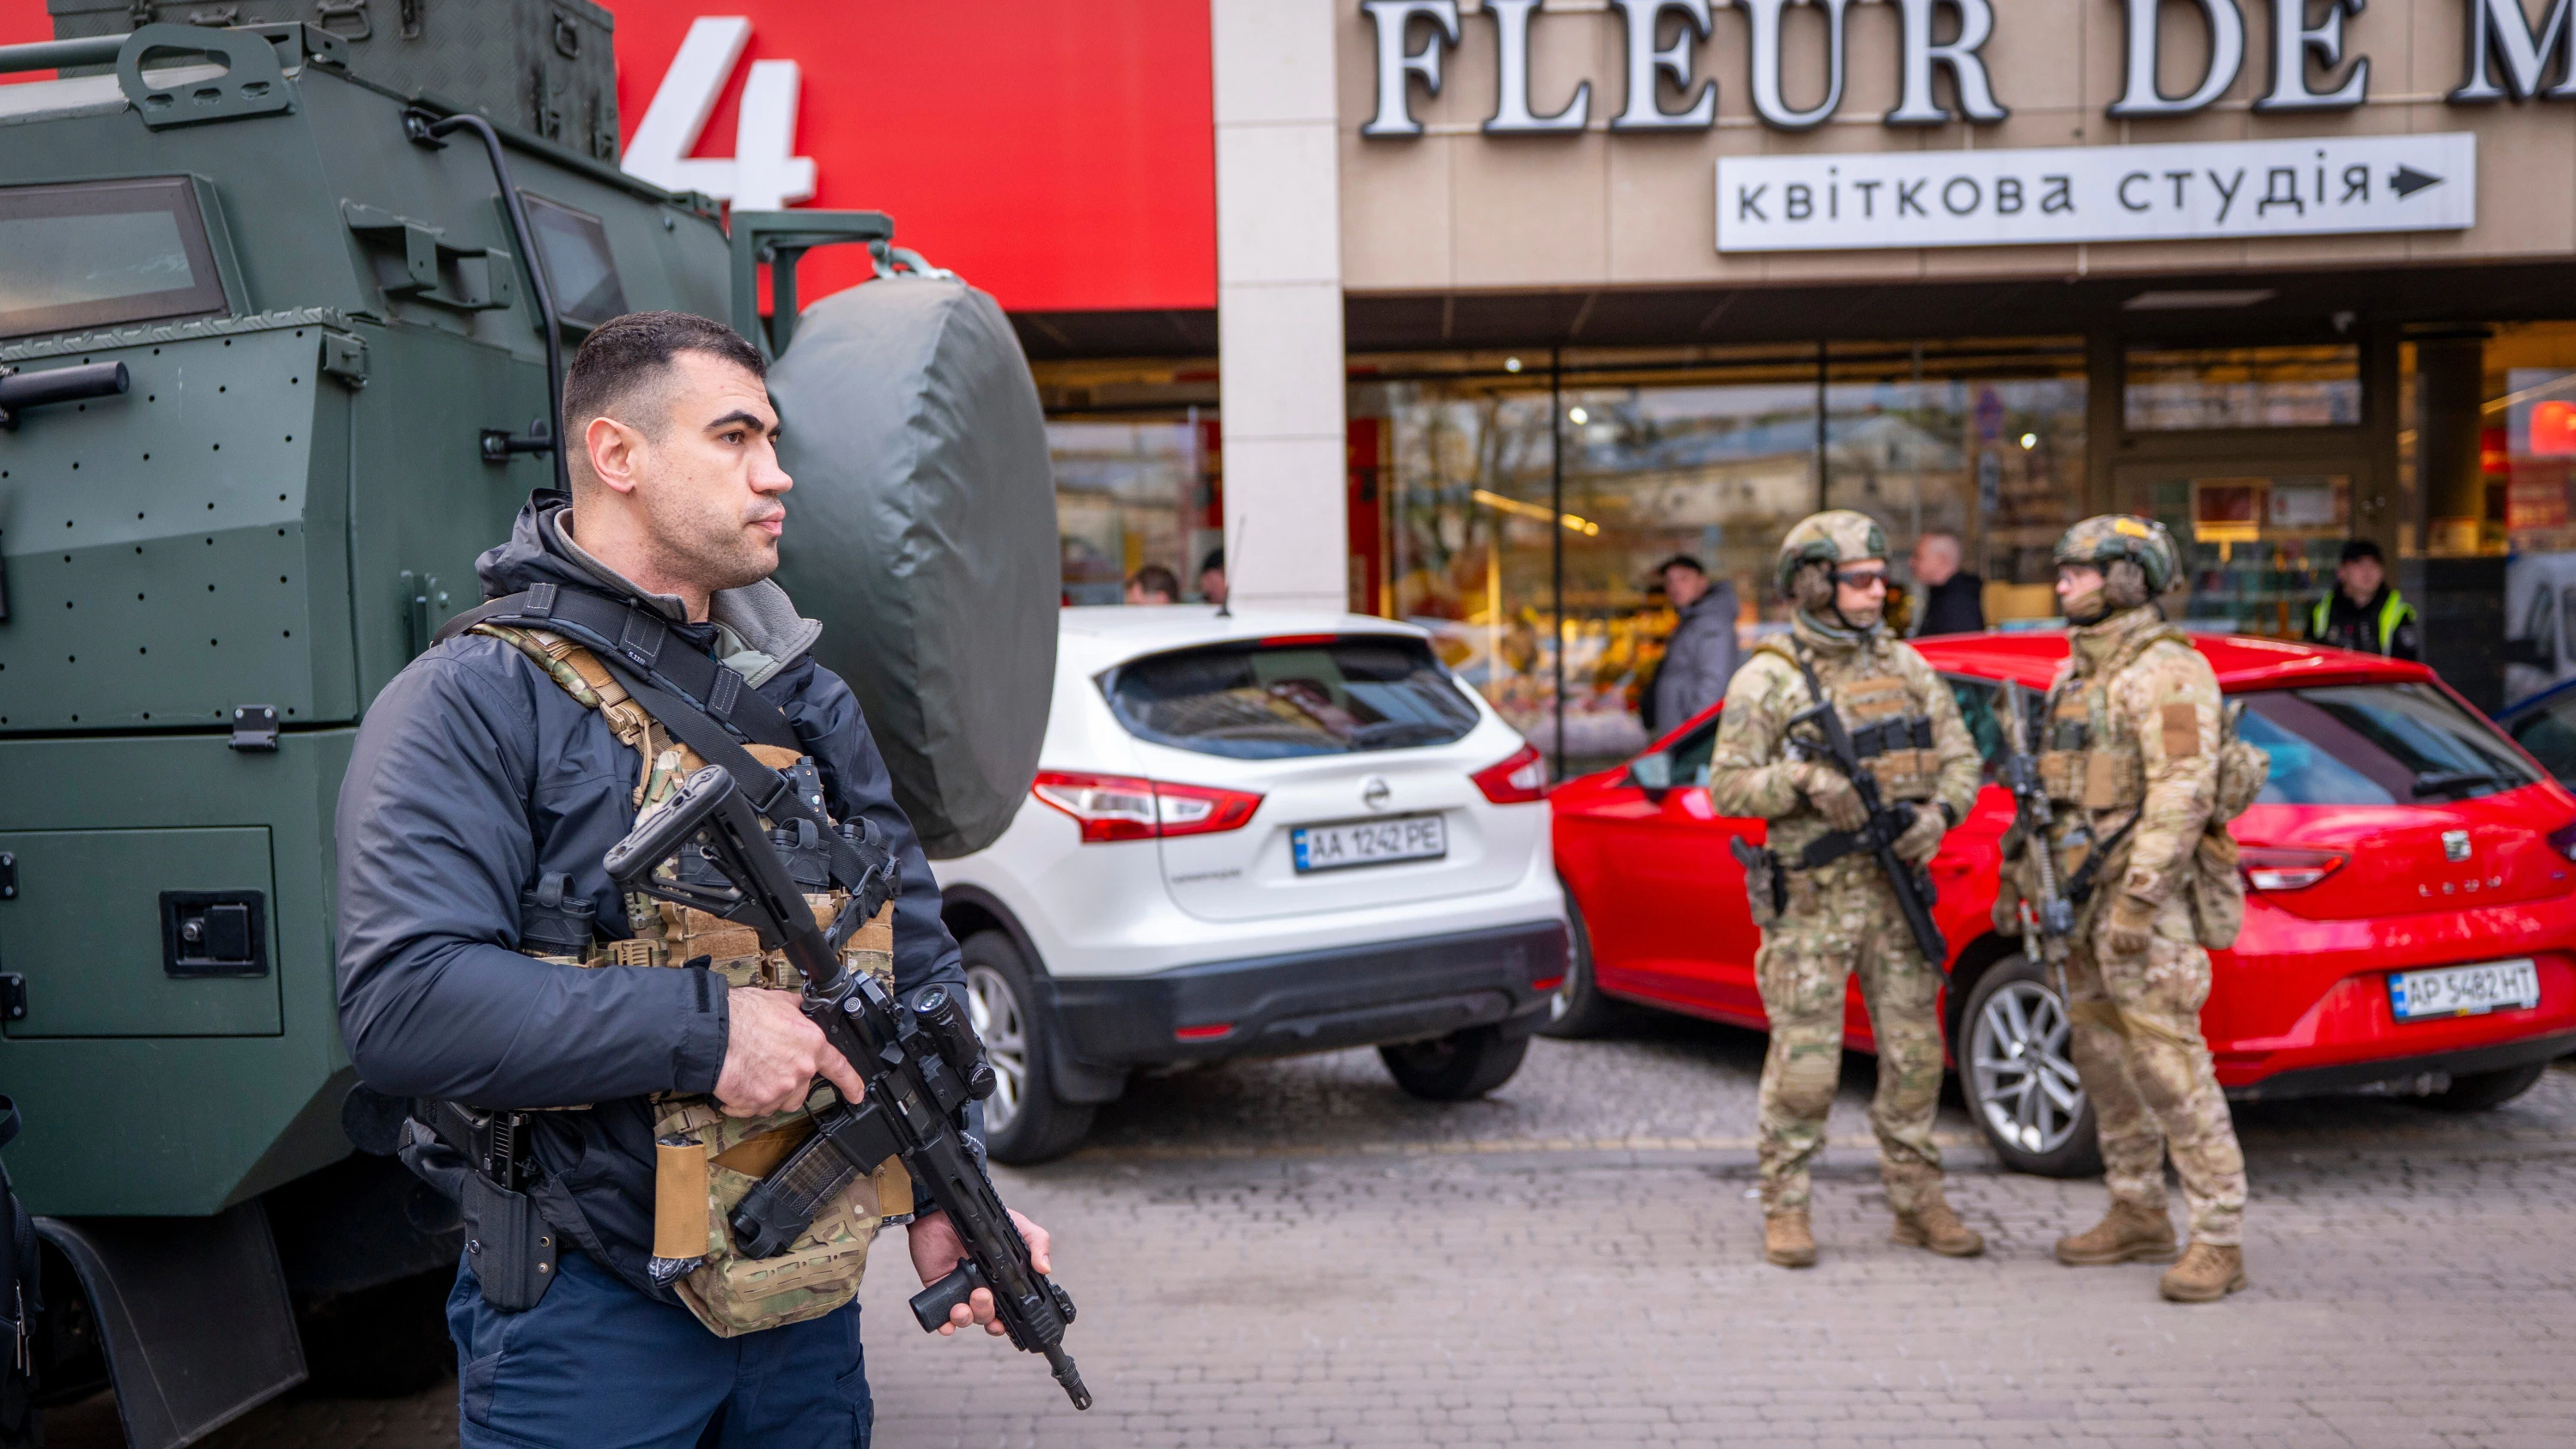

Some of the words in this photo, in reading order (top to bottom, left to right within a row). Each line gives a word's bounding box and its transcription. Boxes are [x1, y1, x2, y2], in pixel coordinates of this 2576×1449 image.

[1360, 0, 2009, 137] FLEUR
[2105, 0, 2371, 118] DE
[620, 15, 818, 210] 4
[1737, 166, 2075, 223] квіткова
[2117, 148, 2371, 226] студія
[1312, 832, 1343, 858] AA
[1406, 819, 1437, 849] PE
[2409, 975, 2441, 1006] AP
[2500, 966, 2532, 996] HT
